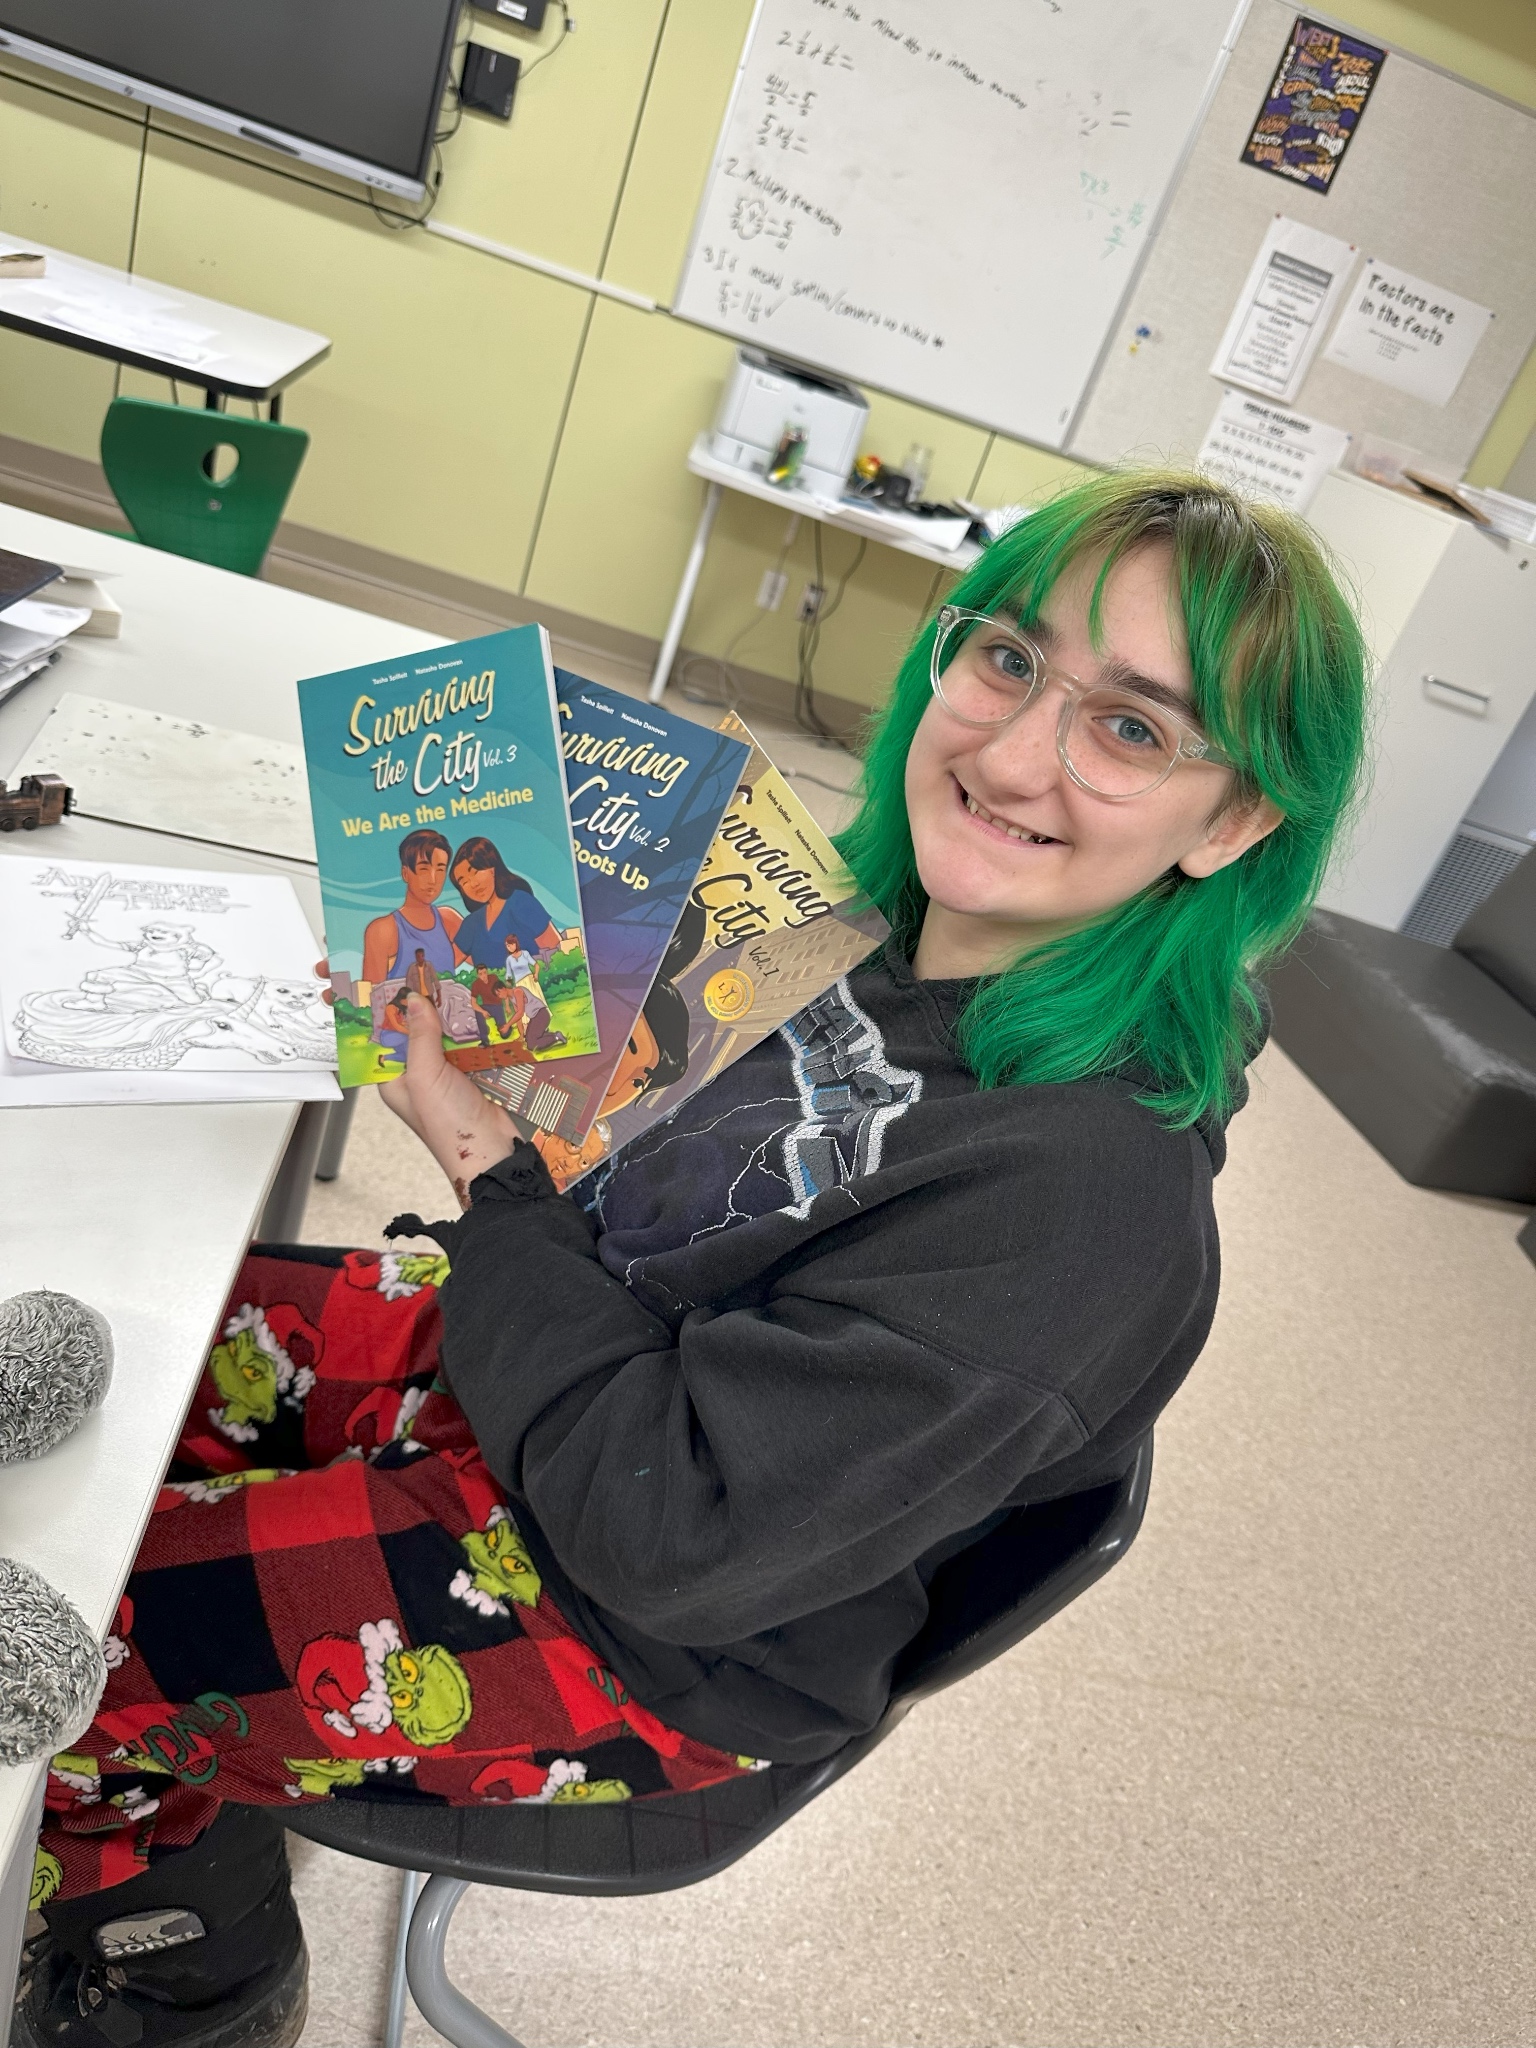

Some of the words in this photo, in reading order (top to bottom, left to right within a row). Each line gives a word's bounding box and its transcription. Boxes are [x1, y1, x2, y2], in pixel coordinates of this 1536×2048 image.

[1377, 302, 1401, 328] the
[1429, 304, 1455, 325] are
[343, 670, 496, 757] Surviving
[621, 712, 643, 727] Natasha
[643, 722, 668, 737] Donovan
[370, 750, 409, 792] the
[412, 730, 483, 796] City
[483, 748, 503, 768] Vol.
[506, 744, 518, 763] 3
[341, 817, 374, 838] We
[379, 811, 411, 832] Are
[415, 804, 446, 825] the
[450, 787, 535, 818] Medicine
[629, 825, 652, 847] Vol.
[654, 837, 671, 853] 2
[795, 829, 812, 851] Natasha
[810, 850, 829, 875] Donovan
[621, 863, 650, 891] Up
[691, 873, 770, 949] City
[749, 945, 771, 970] Vol.
[763, 967, 780, 978] 1
[104, 1930, 203, 1957] SOREL
